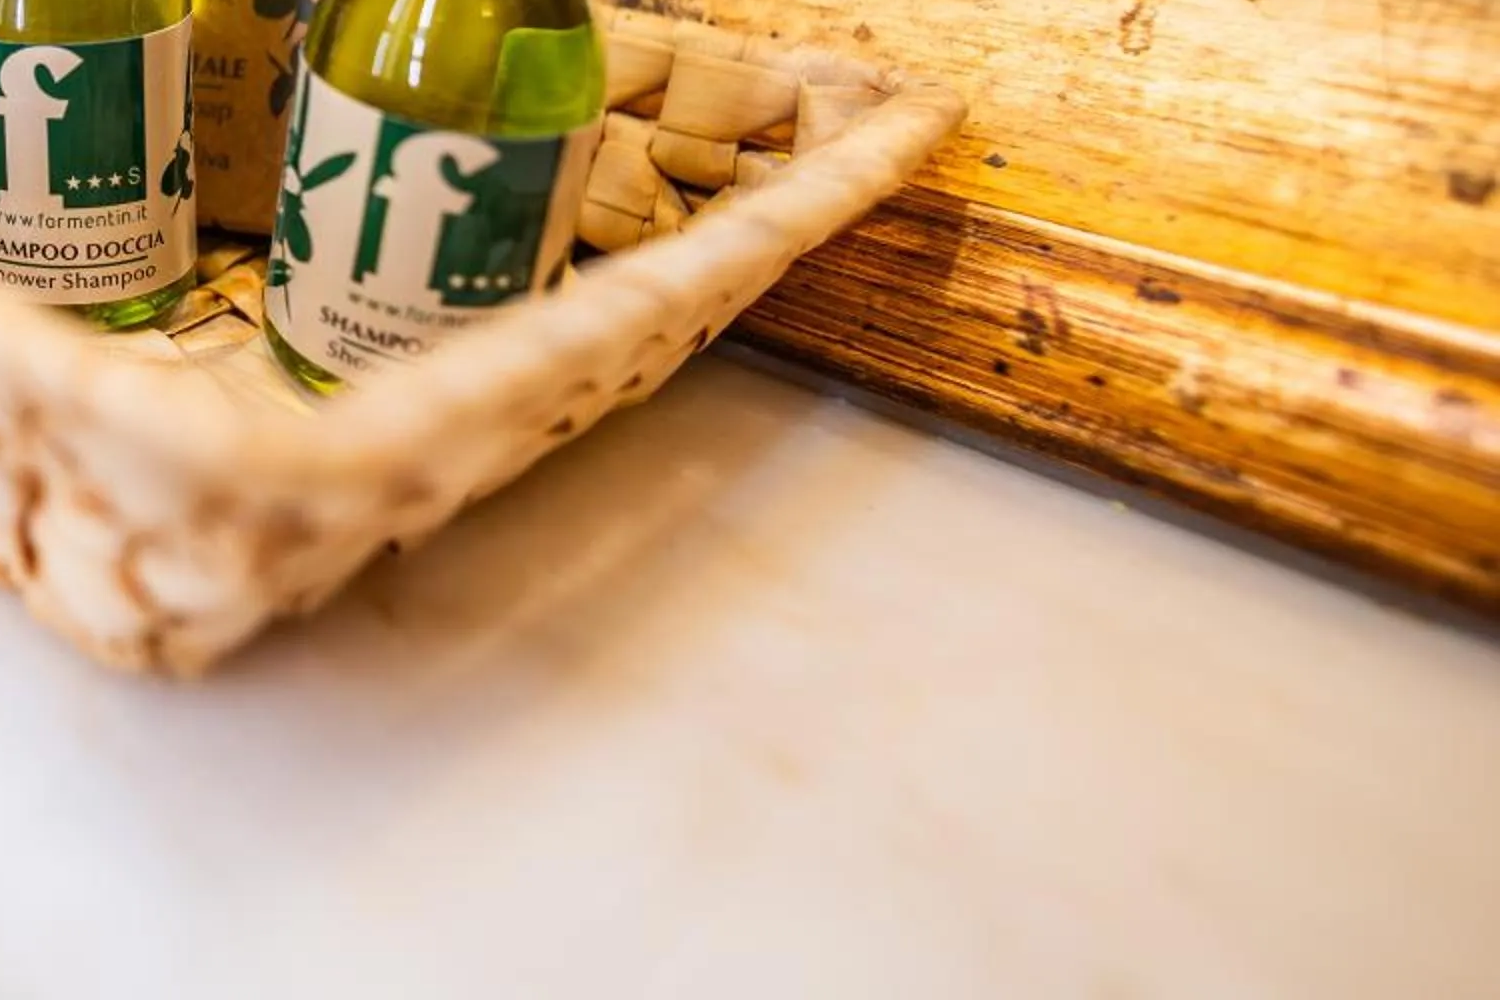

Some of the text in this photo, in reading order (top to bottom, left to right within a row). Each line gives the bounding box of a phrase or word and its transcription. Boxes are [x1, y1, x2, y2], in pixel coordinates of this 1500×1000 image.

[363, 131, 500, 303] f
[86, 232, 165, 260] DOCCIA
[62, 264, 157, 290] Shampoo
[318, 305, 432, 355] SHAMPO
